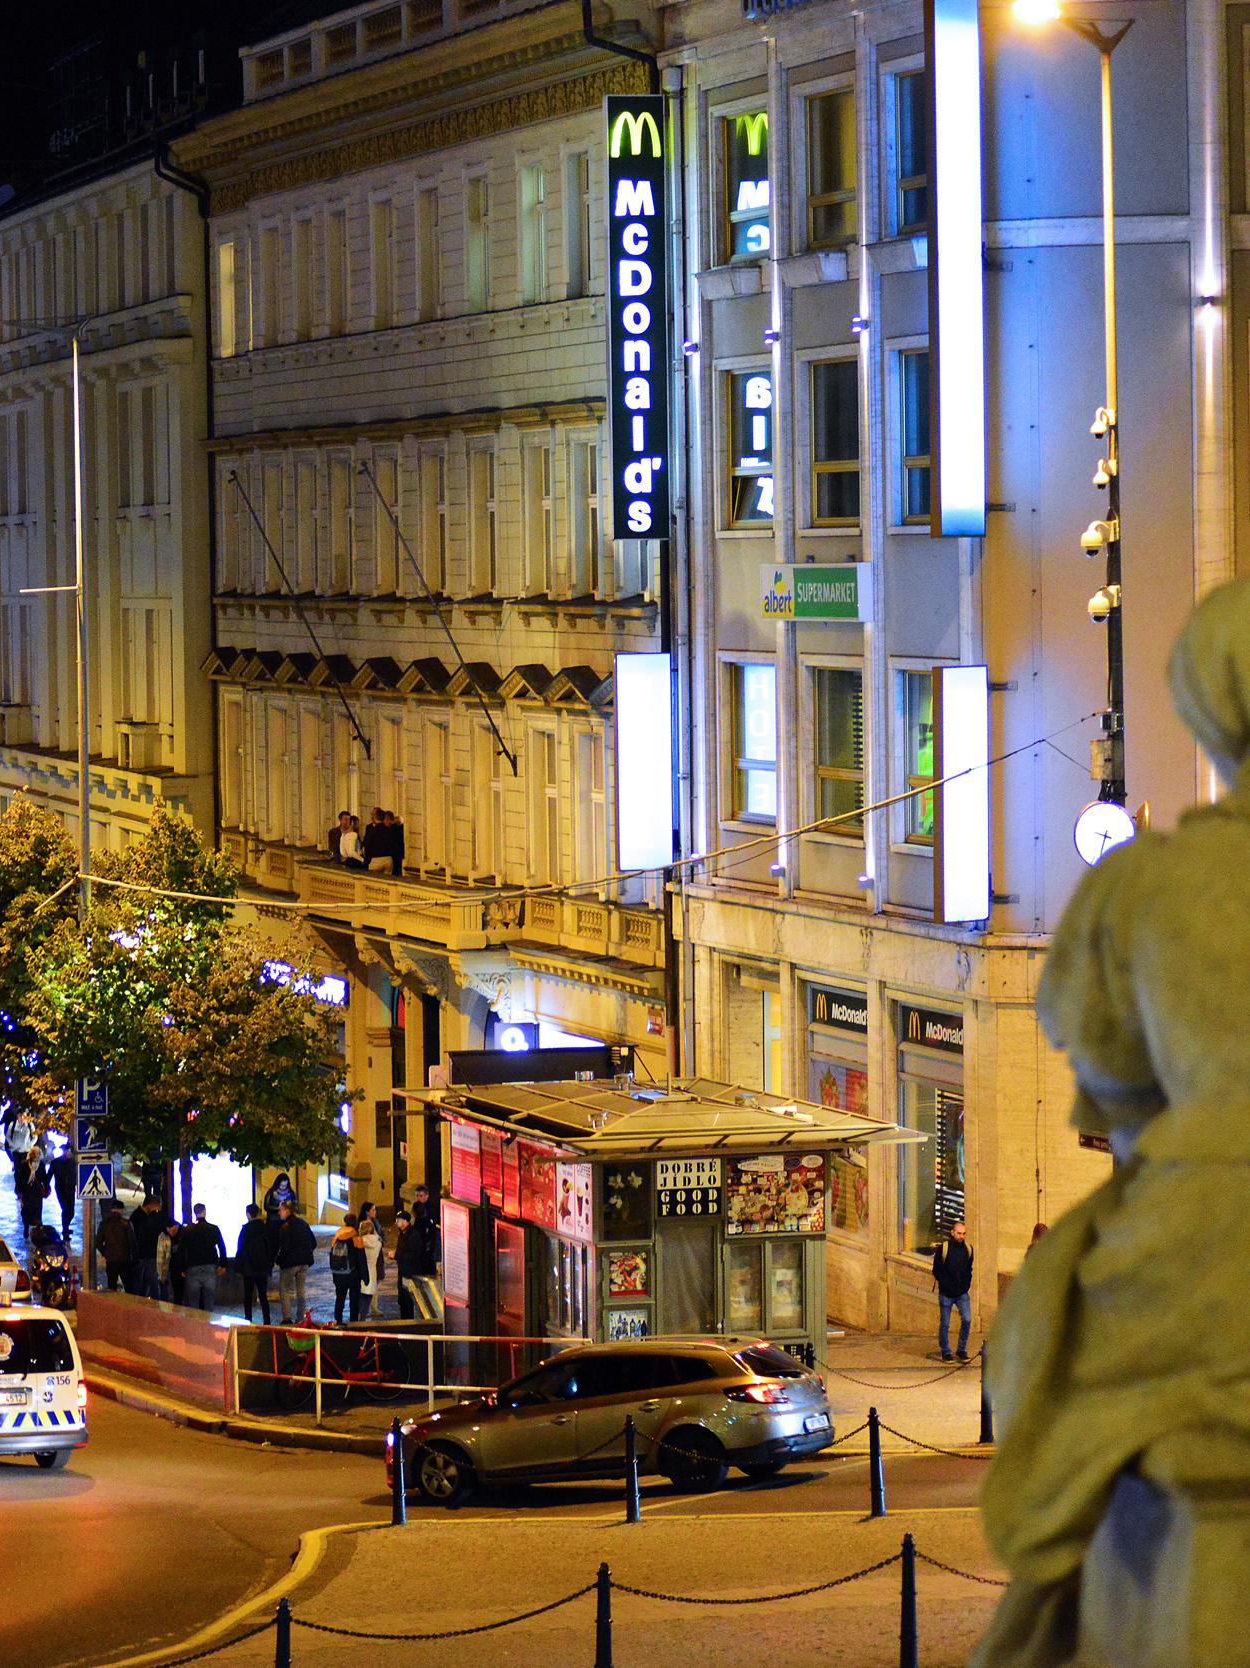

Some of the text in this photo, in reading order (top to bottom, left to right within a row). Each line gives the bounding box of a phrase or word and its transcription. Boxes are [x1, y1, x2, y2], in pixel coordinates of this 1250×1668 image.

[614, 179, 662, 533] McDonald's
[764, 582, 855, 613] albert SUPERMARKET
[660, 1158, 717, 1174] DOBRÉ
[660, 1174, 717, 1187] JÍDLO
[660, 1189, 718, 1203] GOOD
[661, 1202, 718, 1216] FOOD
[56, 1375, 71, 1386] 156
